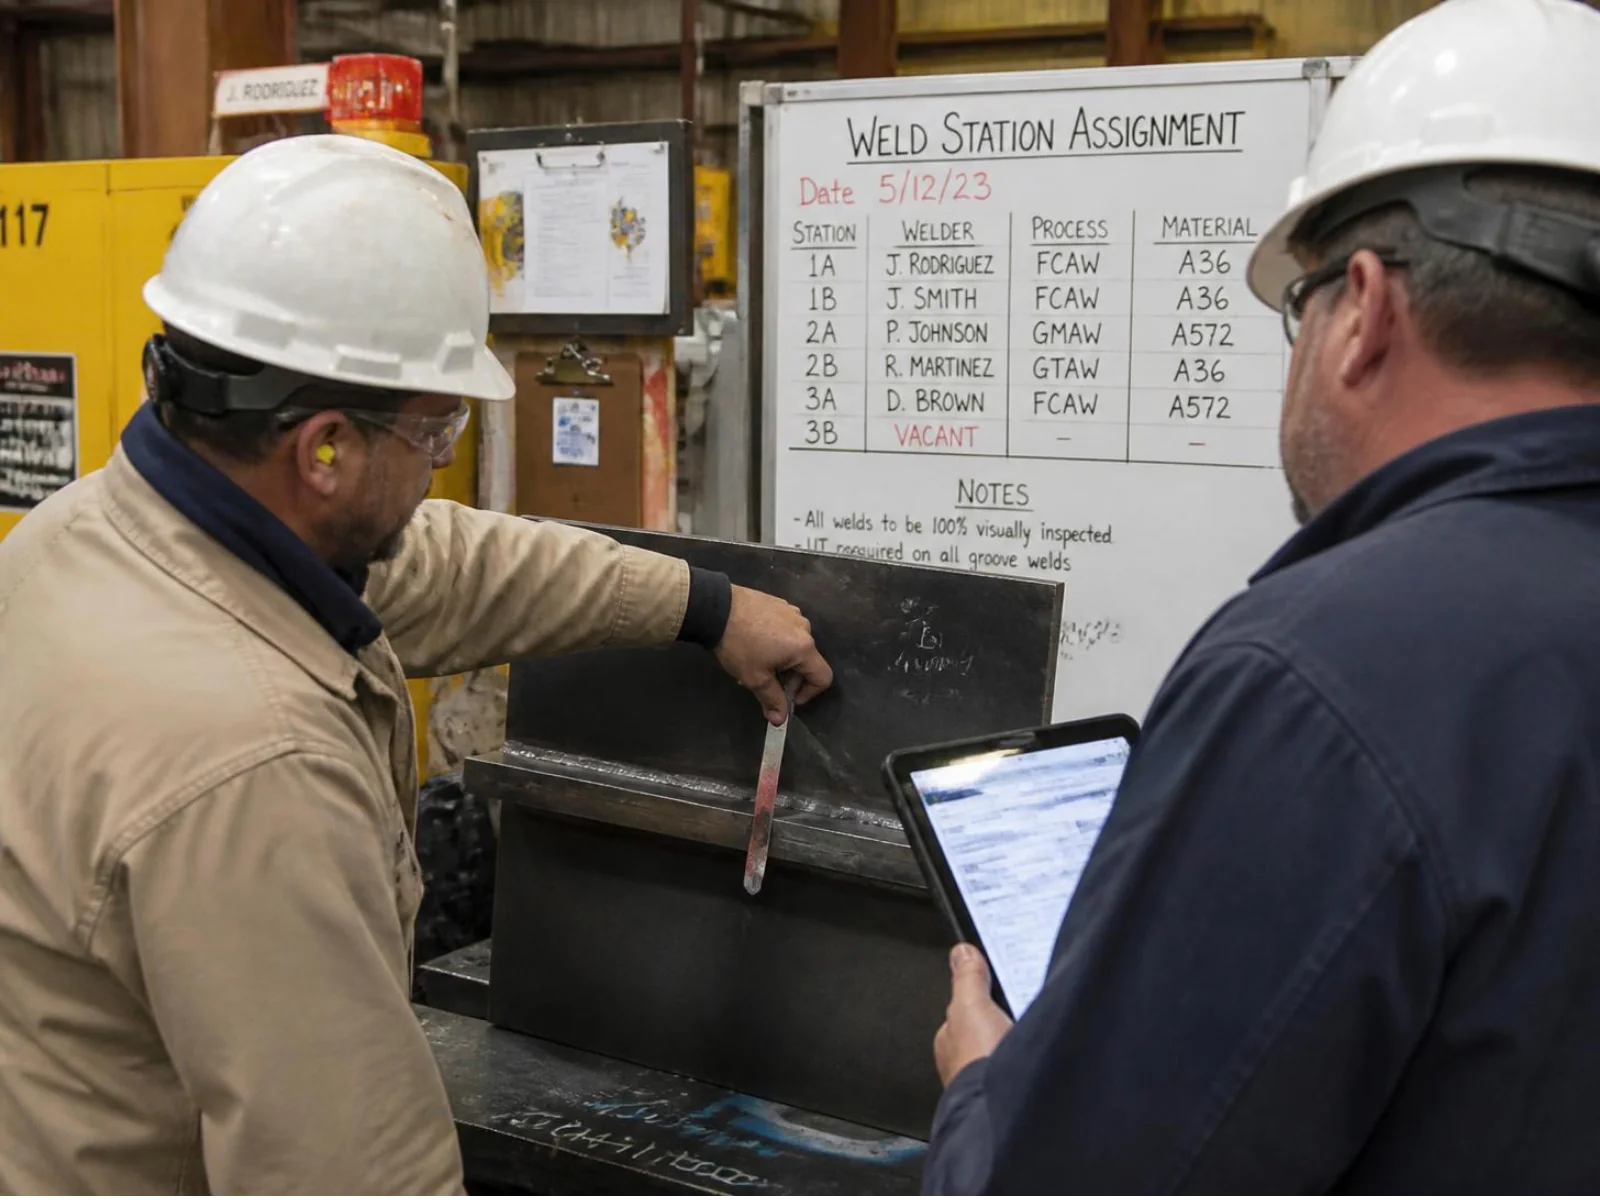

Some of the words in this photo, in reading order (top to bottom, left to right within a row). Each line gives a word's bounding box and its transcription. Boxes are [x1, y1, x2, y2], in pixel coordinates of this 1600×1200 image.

[846, 115, 929, 159] WELD
[941, 111, 1055, 156] STATION
[1068, 105, 1247, 151] ASSIGNMENT
[799, 176, 855, 207] Date
[879, 169, 992, 204] 5/12/23
[793, 220, 856, 245] STATION
[901, 219, 974, 243] WELDER
[1031, 215, 1109, 240] PROCESS
[1161, 215, 1258, 239] MATERIAL
[808, 253, 836, 278] 1A
[885, 252, 902, 277] J.
[908, 251, 995, 275] RODRIGUEZ
[1037, 250, 1101, 275] FCAW
[1178, 249, 1232, 275] A36
[809, 286, 837, 312] 1B
[886, 286, 903, 311] J.
[914, 285, 977, 311] SMITH
[1035, 285, 1100, 310] FCAW
[1175, 285, 1230, 311] A36
[805, 319, 837, 344] 2A
[886, 318, 901, 344] P.
[907, 320, 988, 344] JOHNSON
[1032, 320, 1103, 345] GMAW
[1171, 321, 1235, 347] A572
[805, 352, 839, 378] 2B
[885, 353, 903, 378] R.
[909, 355, 995, 379] MARTINEZ
[1032, 355, 1100, 380] GTAW
[1172, 357, 1226, 384] A36
[805, 385, 837, 411] 3A
[886, 388, 906, 413] D.
[915, 388, 985, 413] BROWN
[1033, 390, 1099, 416] FCAW
[1168, 394, 1232, 420] A572
[804, 419, 838, 446] 3B
[894, 424, 978, 447] VACANT
[957, 478, 1030, 507] NOTES
[804, 509, 824, 529] All
[832, 512, 874, 532] welds
[880, 513, 897, 532] to
[905, 515, 923, 535] be
[932, 516, 968, 536] 100%
[975, 519, 1032, 549] visually
[1040, 521, 1113, 551] inspected
[911, 548, 932, 563] on
[939, 545, 960, 564] all
[968, 553, 1018, 571] groove
[1027, 551, 1073, 571] welds
